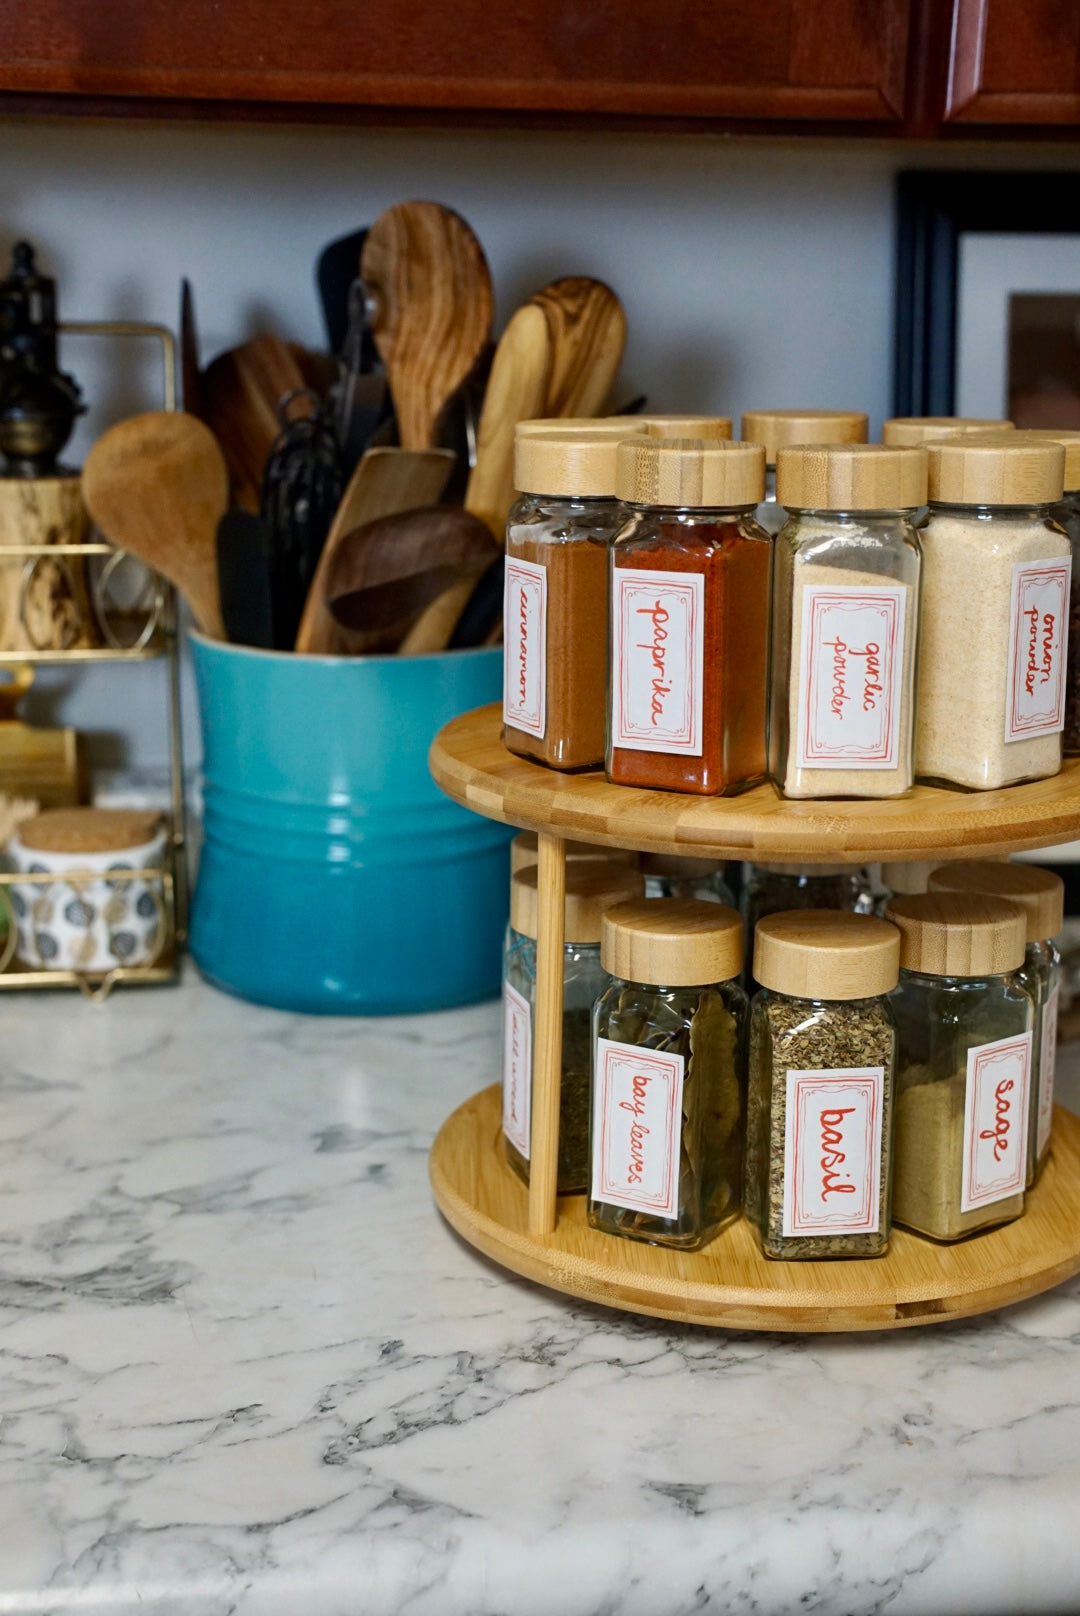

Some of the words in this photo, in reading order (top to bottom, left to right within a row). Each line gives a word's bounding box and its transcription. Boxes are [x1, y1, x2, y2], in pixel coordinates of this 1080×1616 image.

[518, 587, 532, 707] cinnamon
[636, 600, 672, 726] paprika
[822, 636, 850, 721] powder
[849, 642, 883, 712] garlic
[1024, 604, 1042, 697] powder
[1040, 613, 1058, 685] onion
[619, 1075, 652, 1117] bay
[980, 1078, 1015, 1162] sage
[627, 1120, 651, 1184] leaves
[819, 1107, 857, 1202] basil
